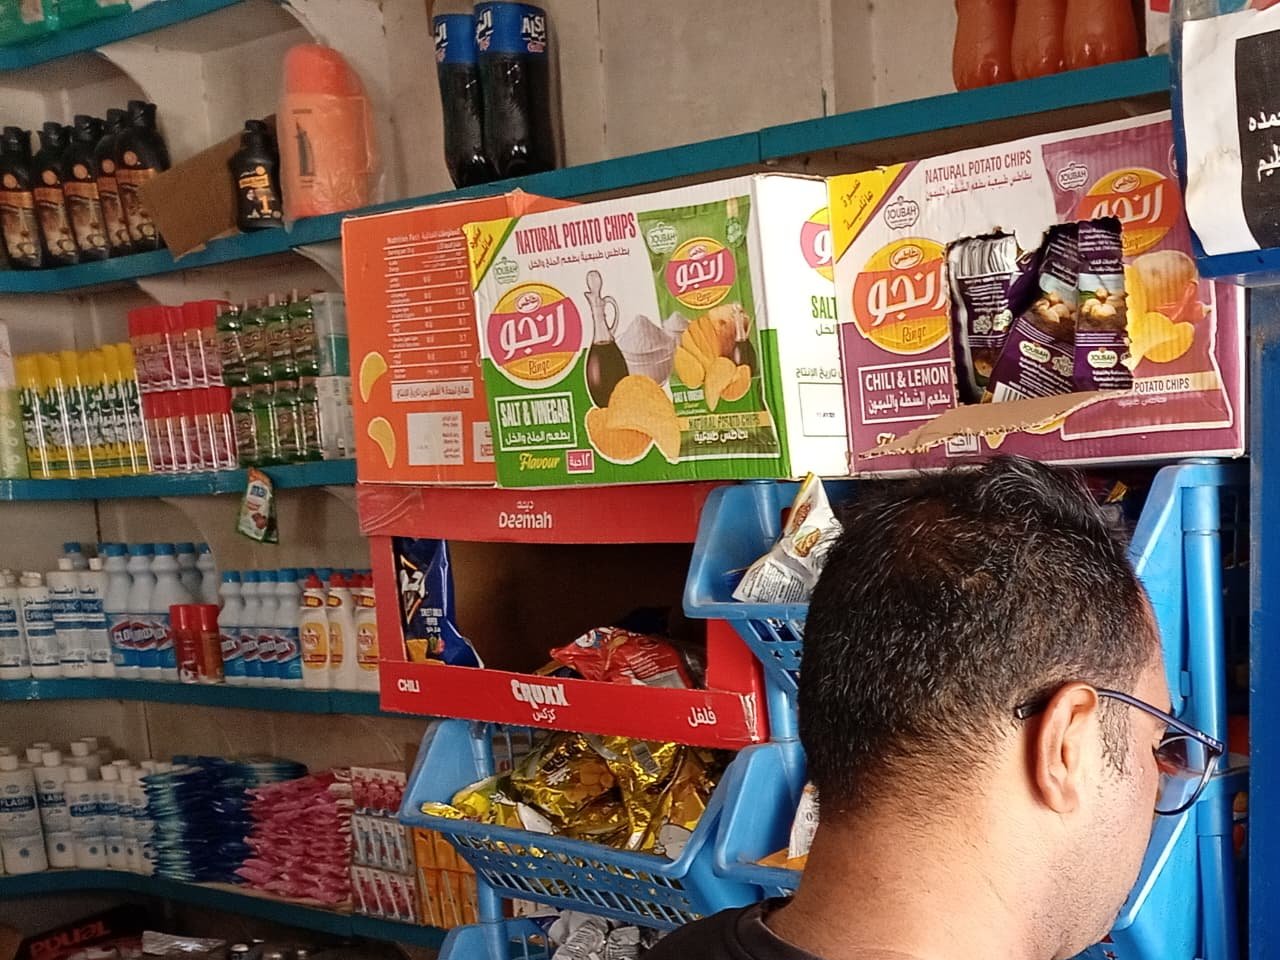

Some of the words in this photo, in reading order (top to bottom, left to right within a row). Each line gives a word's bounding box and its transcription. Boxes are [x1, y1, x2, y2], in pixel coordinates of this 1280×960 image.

[924, 162, 967, 184] NATURAL
[968, 157, 1002, 177] POTATO
[1004, 150, 1032, 170] CHIPS
[515, 225, 562, 256] NATURAL
[563, 219, 601, 248] POTATO
[604, 212, 637, 240] CHIPS
[865, 370, 896, 392] CHILI
[897, 370, 907, 389] &
[908, 366, 950, 387] LEMON
[1134, 380, 1164, 393] POTATO
[1165, 377, 1190, 391] CHIPS
[501, 400, 522, 428] SALT
[521, 399, 532, 425] &
[532, 397, 571, 424] VINEGAR
[518, 452, 561, 471] Flavour
[499, 511, 553, 529] Deemah
[397, 678, 420, 694] CHILI
[688, 705, 717, 728] فلفل
